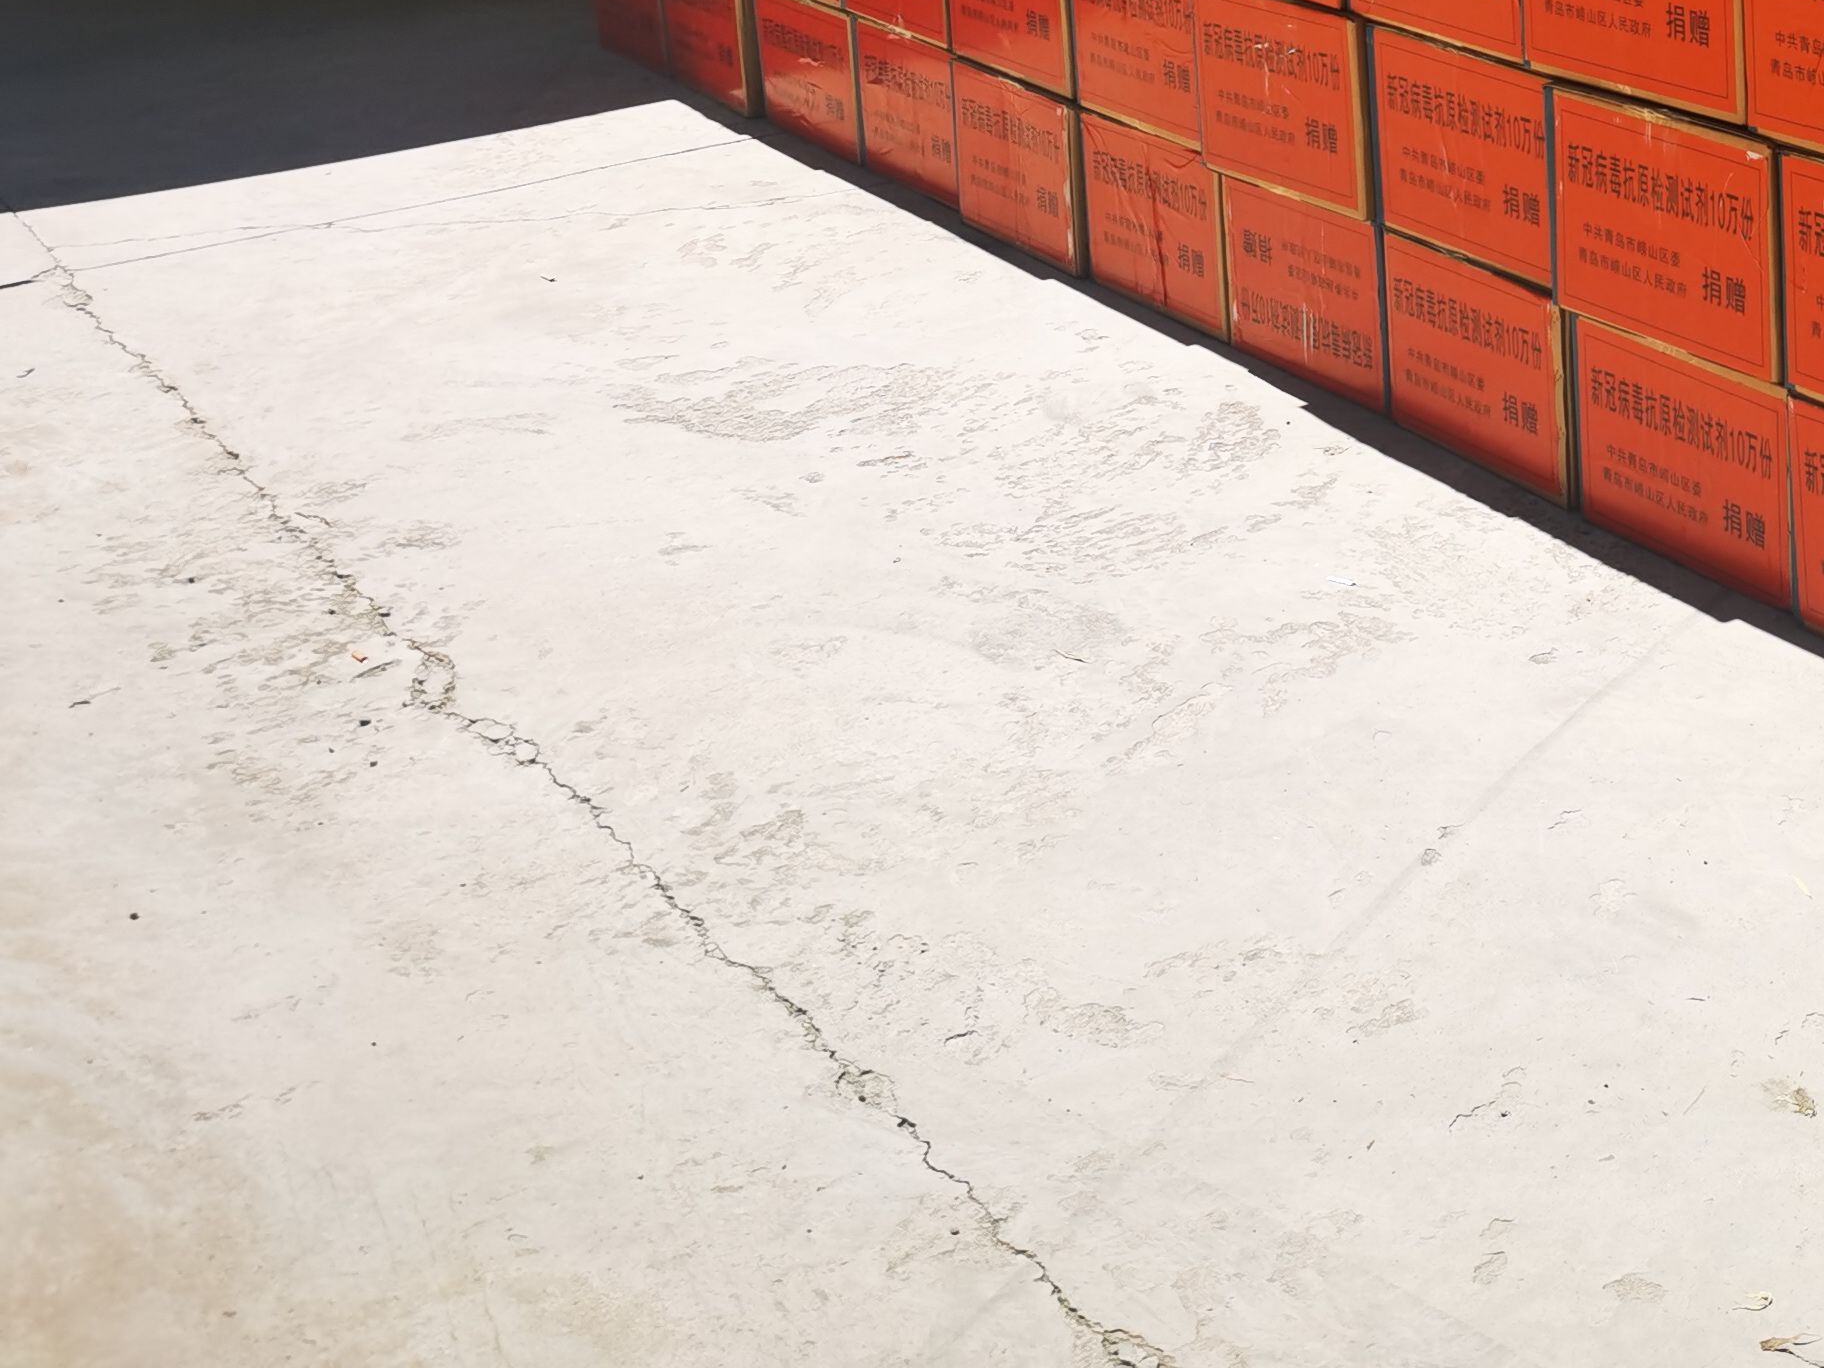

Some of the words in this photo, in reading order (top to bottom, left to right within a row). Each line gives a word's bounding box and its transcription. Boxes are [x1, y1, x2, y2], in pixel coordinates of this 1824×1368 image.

[1664, 1, 1710, 49] 捐赠
[1501, 182, 1540, 228] 捐赠
[1566, 140, 1755, 241] 新冠病毒抗原检测试剂10万份
[1700, 264, 1746, 316] 捐赠
[1501, 390, 1538, 438] 捐赠
[1589, 364, 1773, 480] 新冠病毒抗原检测试剂10万份
[1721, 497, 1766, 550] 捐赠
